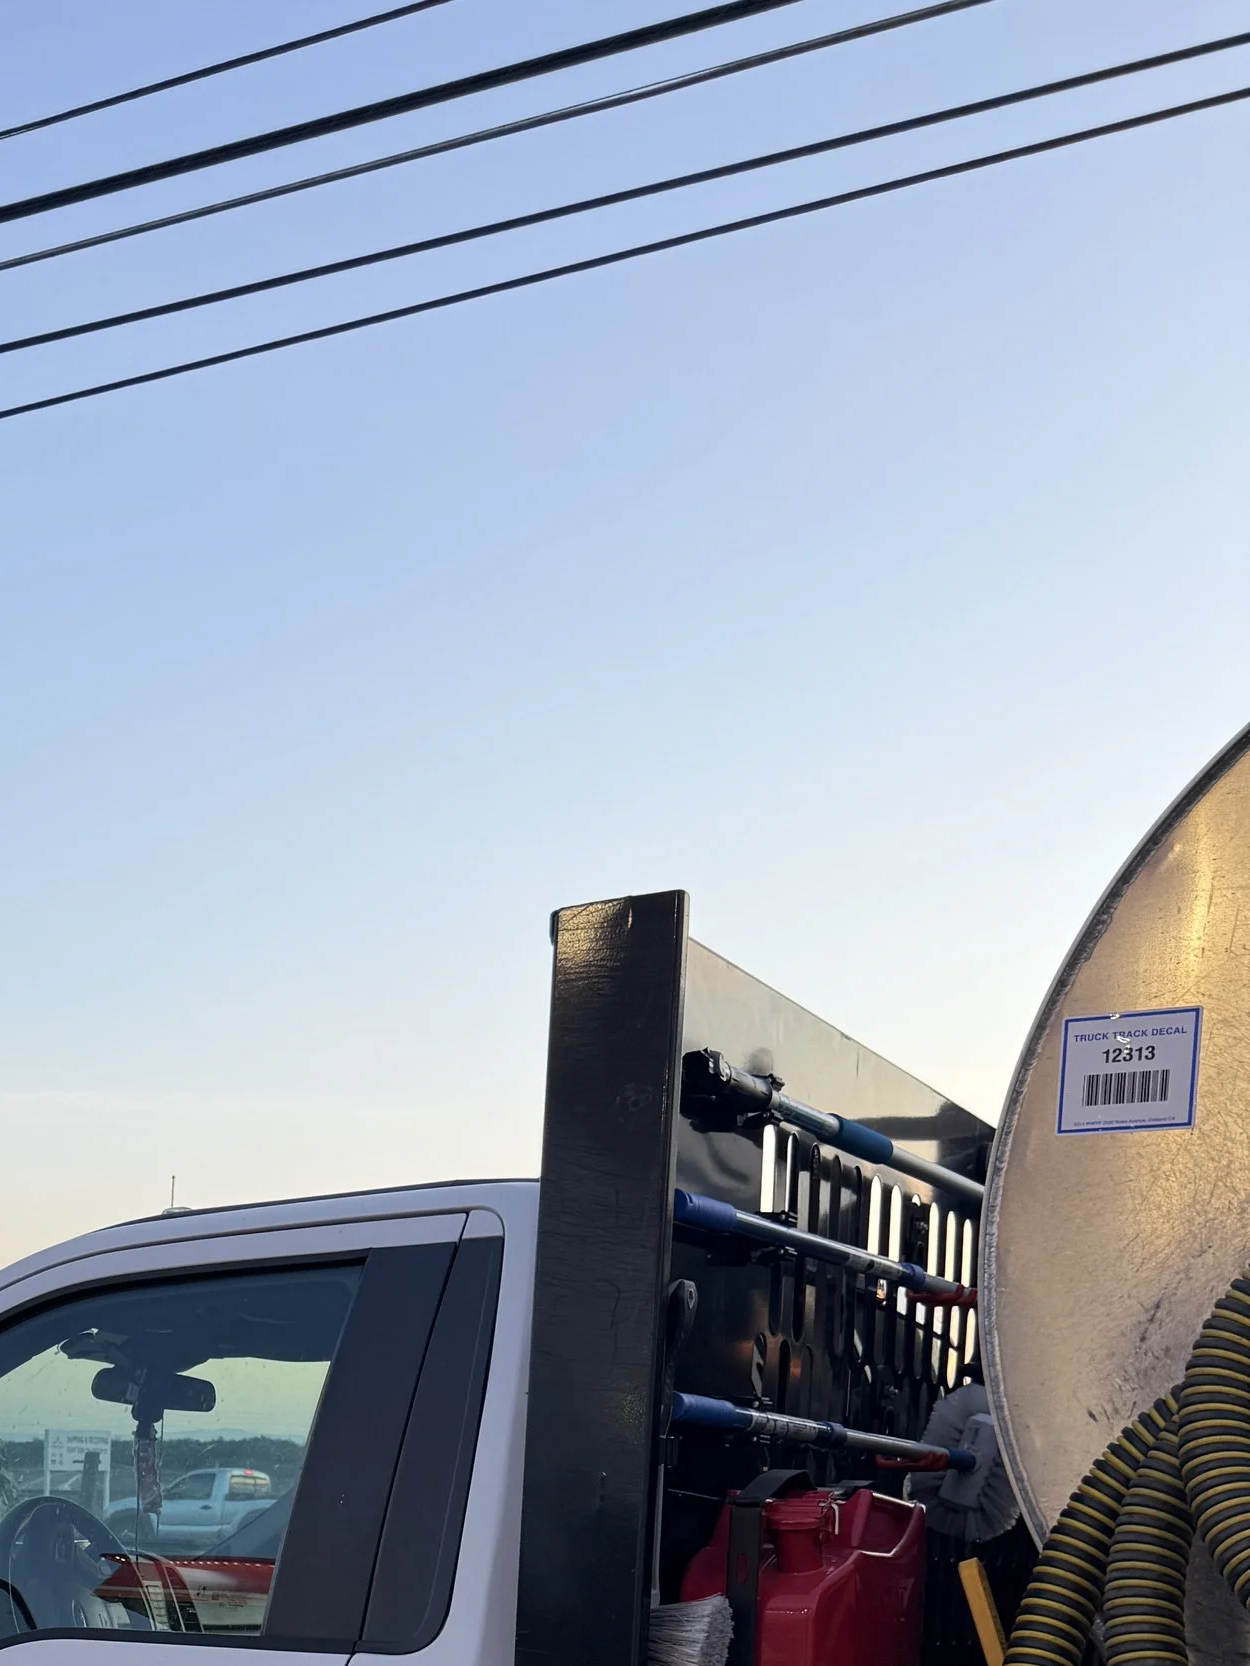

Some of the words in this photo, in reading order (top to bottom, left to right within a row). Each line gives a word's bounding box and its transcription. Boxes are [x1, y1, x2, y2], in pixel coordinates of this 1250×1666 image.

[1074, 1031, 1109, 1043] TRUCK
[1112, 1029, 1149, 1040] TRACK
[1151, 1026, 1188, 1037] DECAL
[1102, 1045, 1156, 1064] 12313
